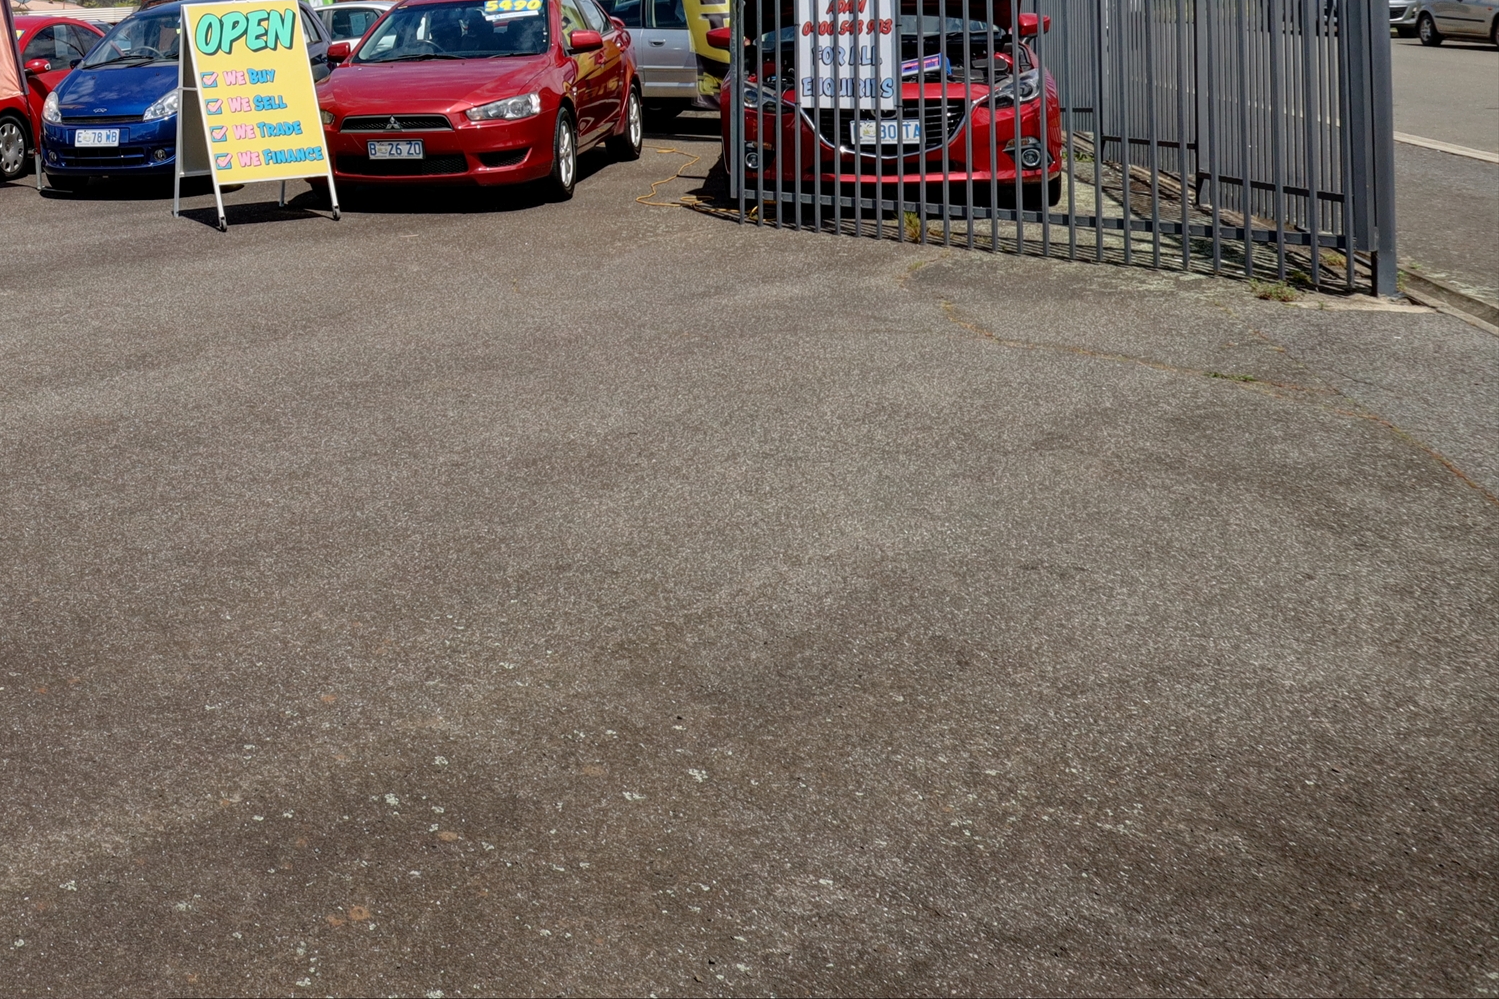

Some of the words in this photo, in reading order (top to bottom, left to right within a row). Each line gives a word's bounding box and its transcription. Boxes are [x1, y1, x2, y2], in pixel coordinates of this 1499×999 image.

[485, 0, 541, 11] 5490
[195, 8, 296, 56] OPEN
[223, 70, 247, 86] WE
[248, 68, 275, 84] BUY
[228, 96, 252, 113] WE
[253, 95, 287, 111] SELL
[232, 123, 256, 140] WE
[257, 121, 302, 138] TRADE
[237, 150, 261, 167] WE
[263, 146, 324, 165] FINANCE
[388, 143, 402, 156] 26
